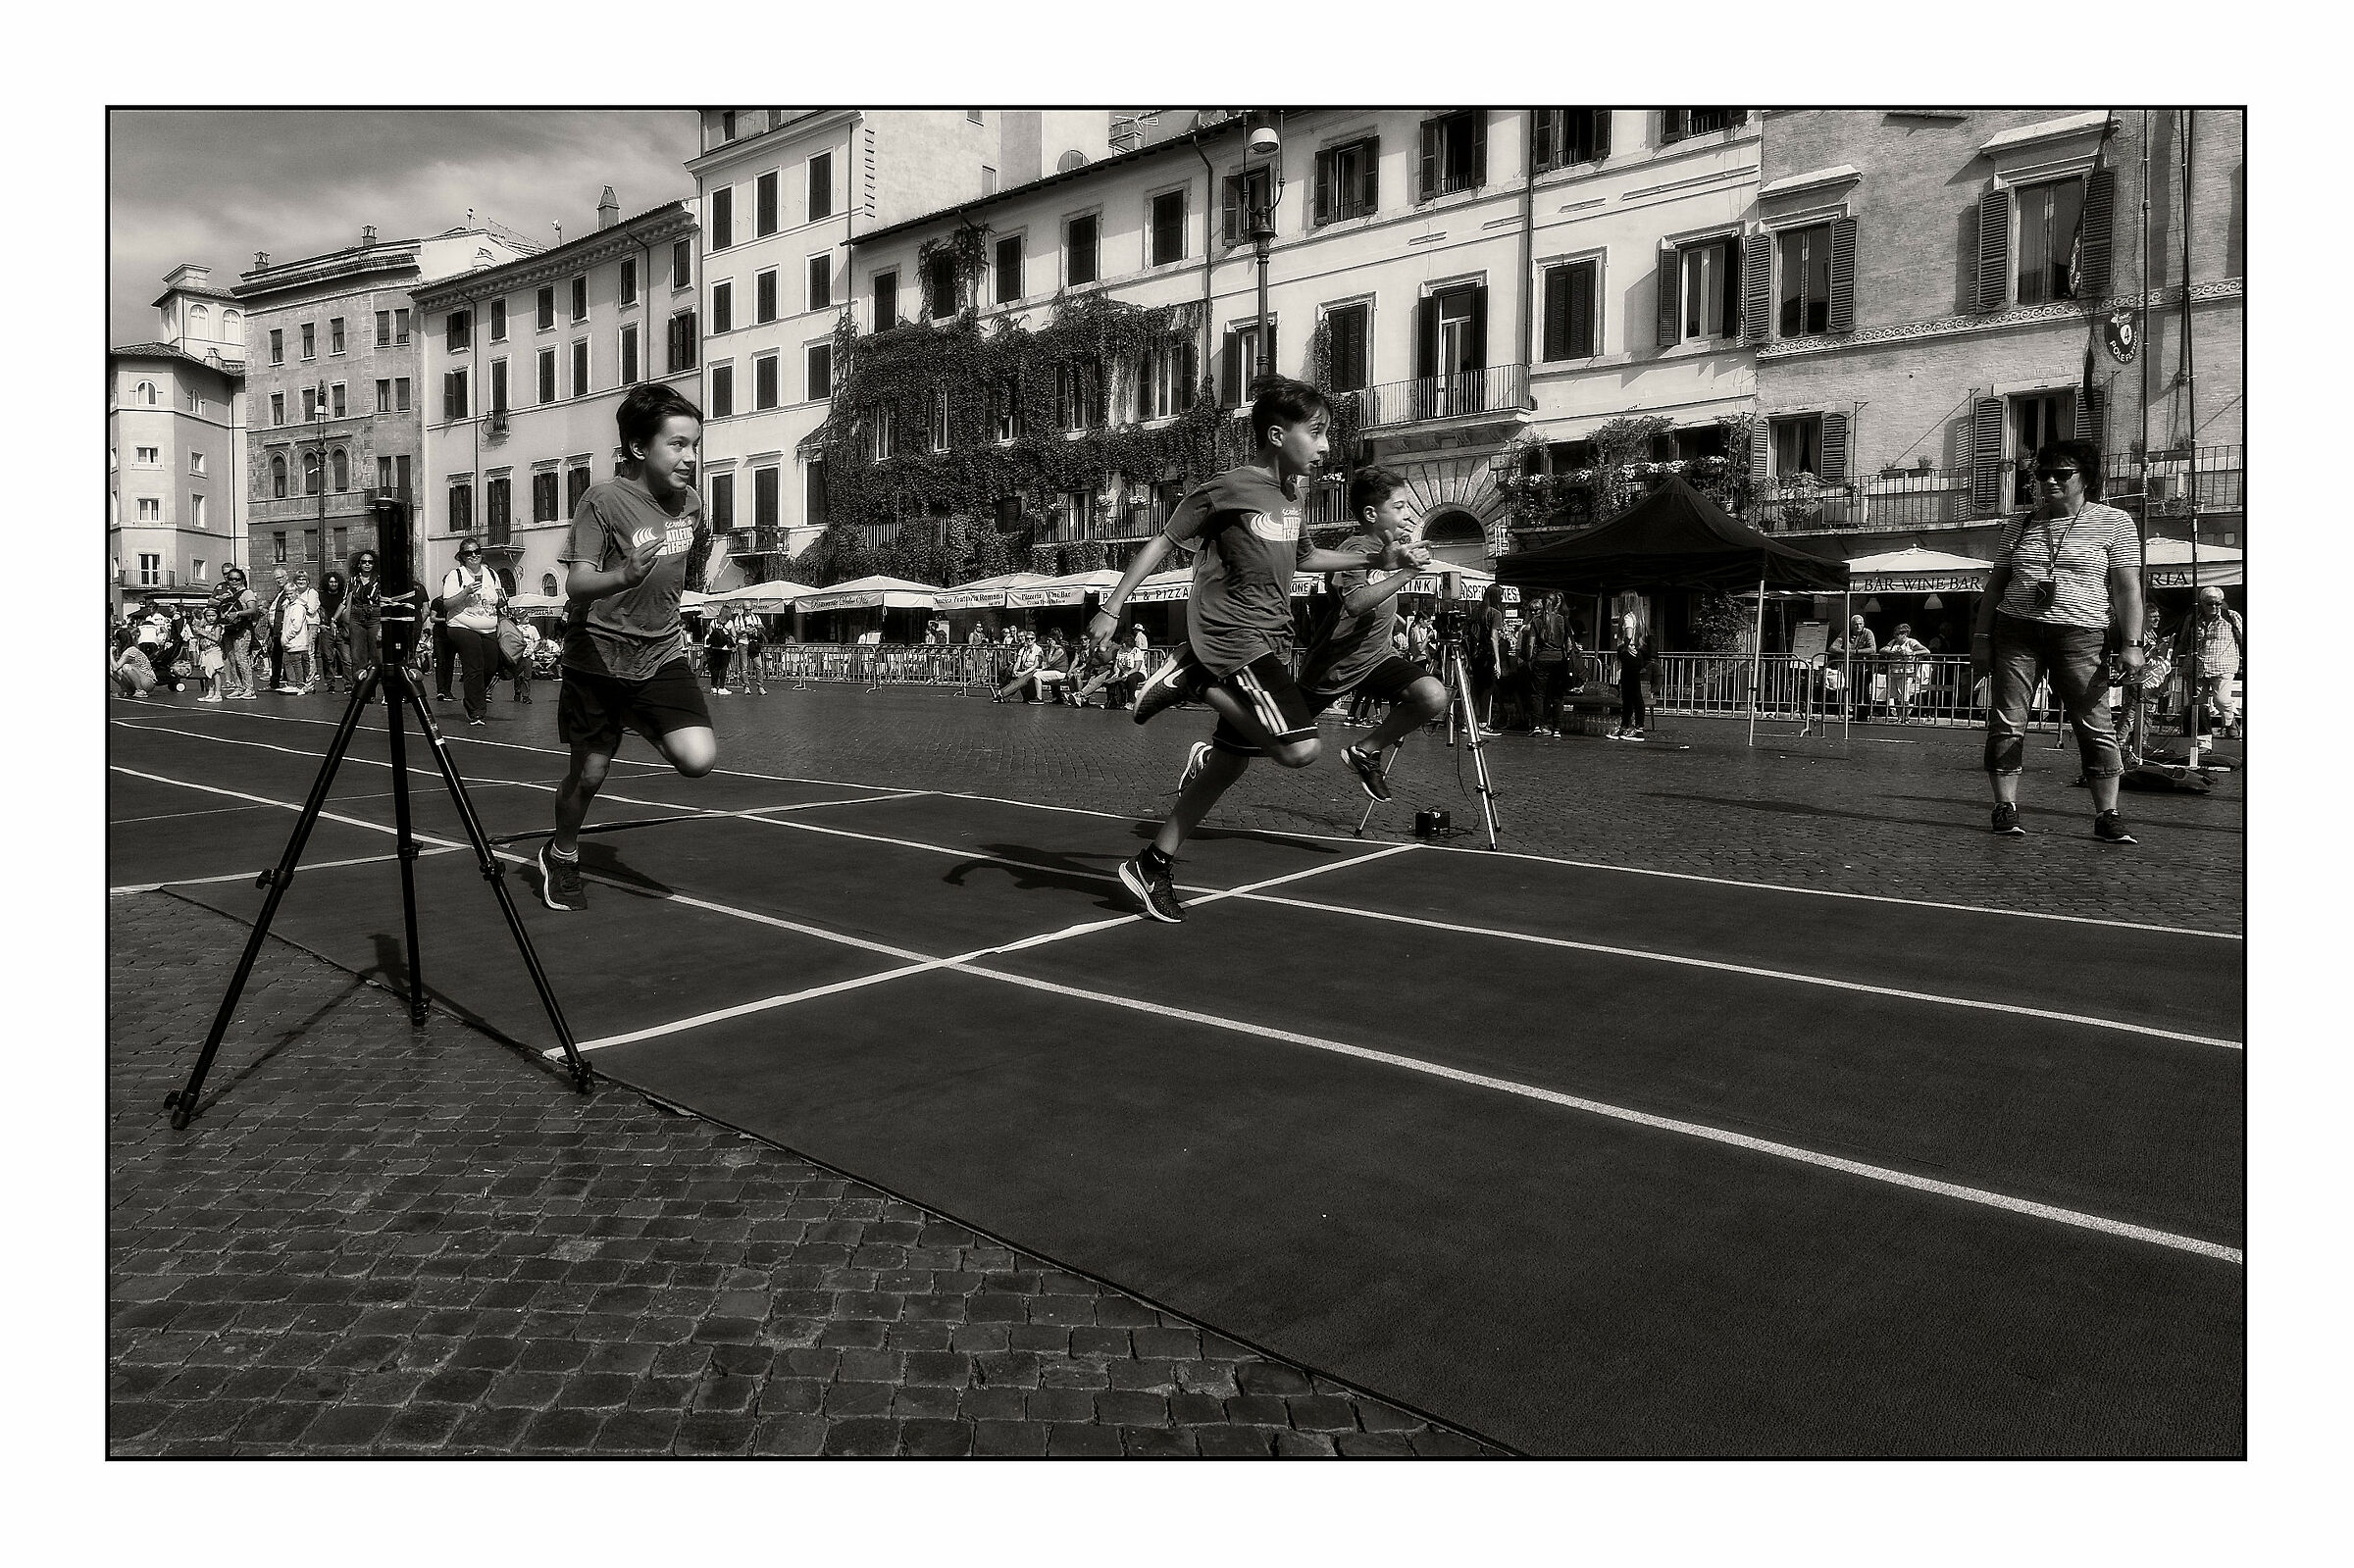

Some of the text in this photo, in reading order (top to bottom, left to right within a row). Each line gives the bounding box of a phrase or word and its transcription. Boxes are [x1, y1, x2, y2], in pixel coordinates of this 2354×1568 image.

[1949, 577, 1981, 590] BAR
[1143, 590, 1151, 601] &
[1155, 587, 1190, 600] PIZZA
